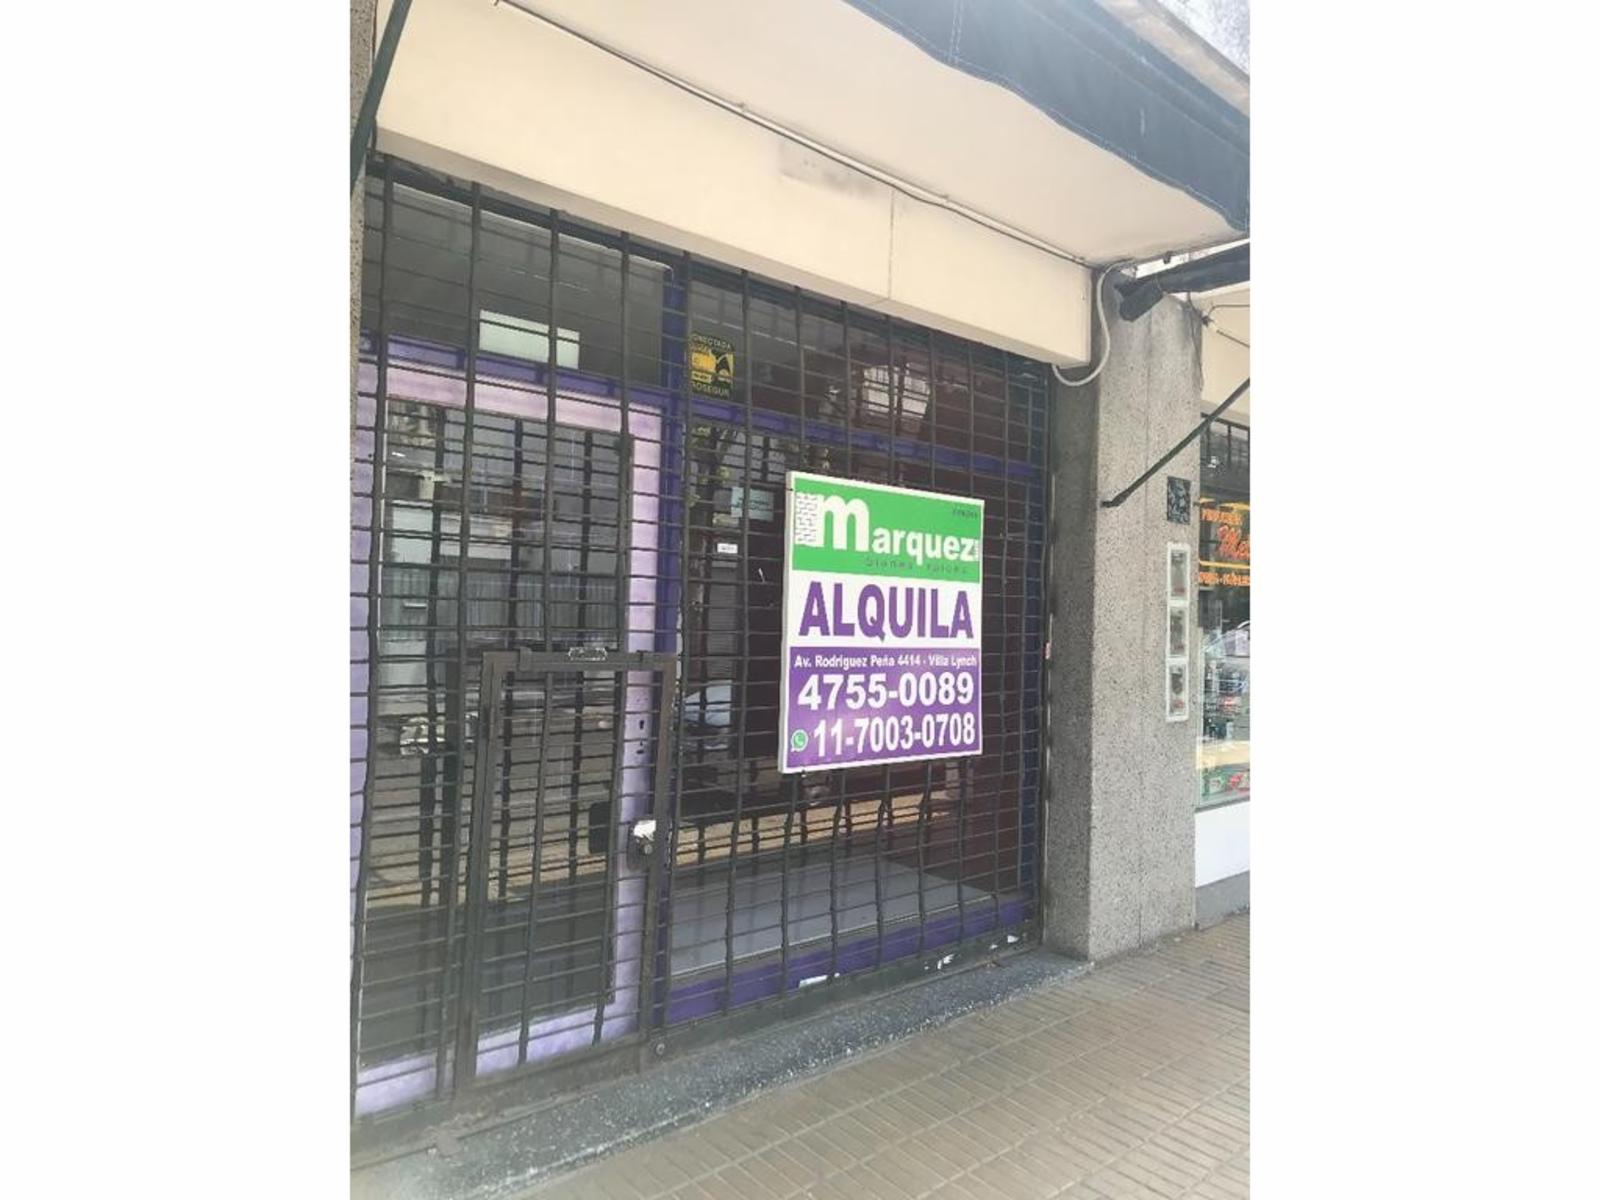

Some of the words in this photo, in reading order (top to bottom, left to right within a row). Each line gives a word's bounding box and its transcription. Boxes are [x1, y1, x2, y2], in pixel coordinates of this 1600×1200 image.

[799, 581, 974, 642] ALQUILA
[794, 654, 812, 668] Av.
[897, 655, 921, 667] 4414
[928, 655, 949, 667] Villa
[951, 655, 977, 670] Lynch
[797, 671, 975, 711] 4755-0089
[813, 711, 976, 758] 11-7003-0708
